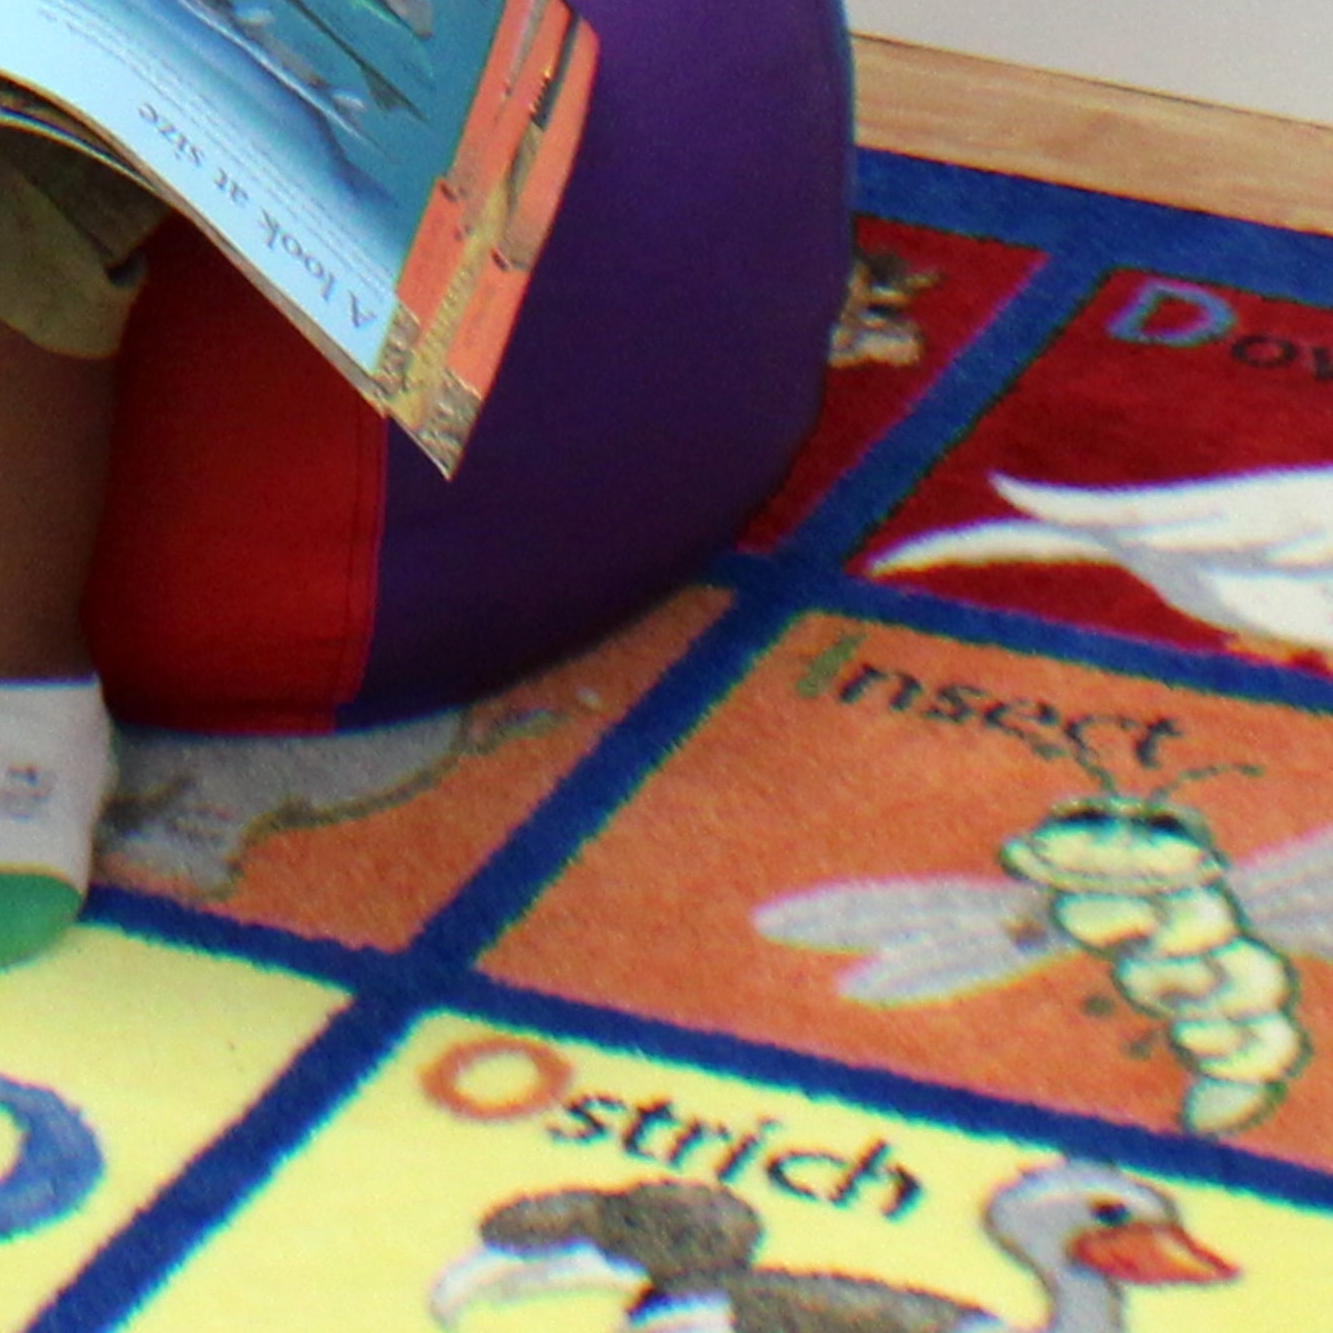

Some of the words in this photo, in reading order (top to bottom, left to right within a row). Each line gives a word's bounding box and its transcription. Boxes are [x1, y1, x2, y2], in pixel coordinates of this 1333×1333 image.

[137, 102, 205, 166] size
[213, 165, 249, 205] at
[258, 205, 335, 301] look
[347, 289, 376, 329] A
[797, 633, 1182, 767] Insect
[418, 1035, 927, 1223] Ostrich
